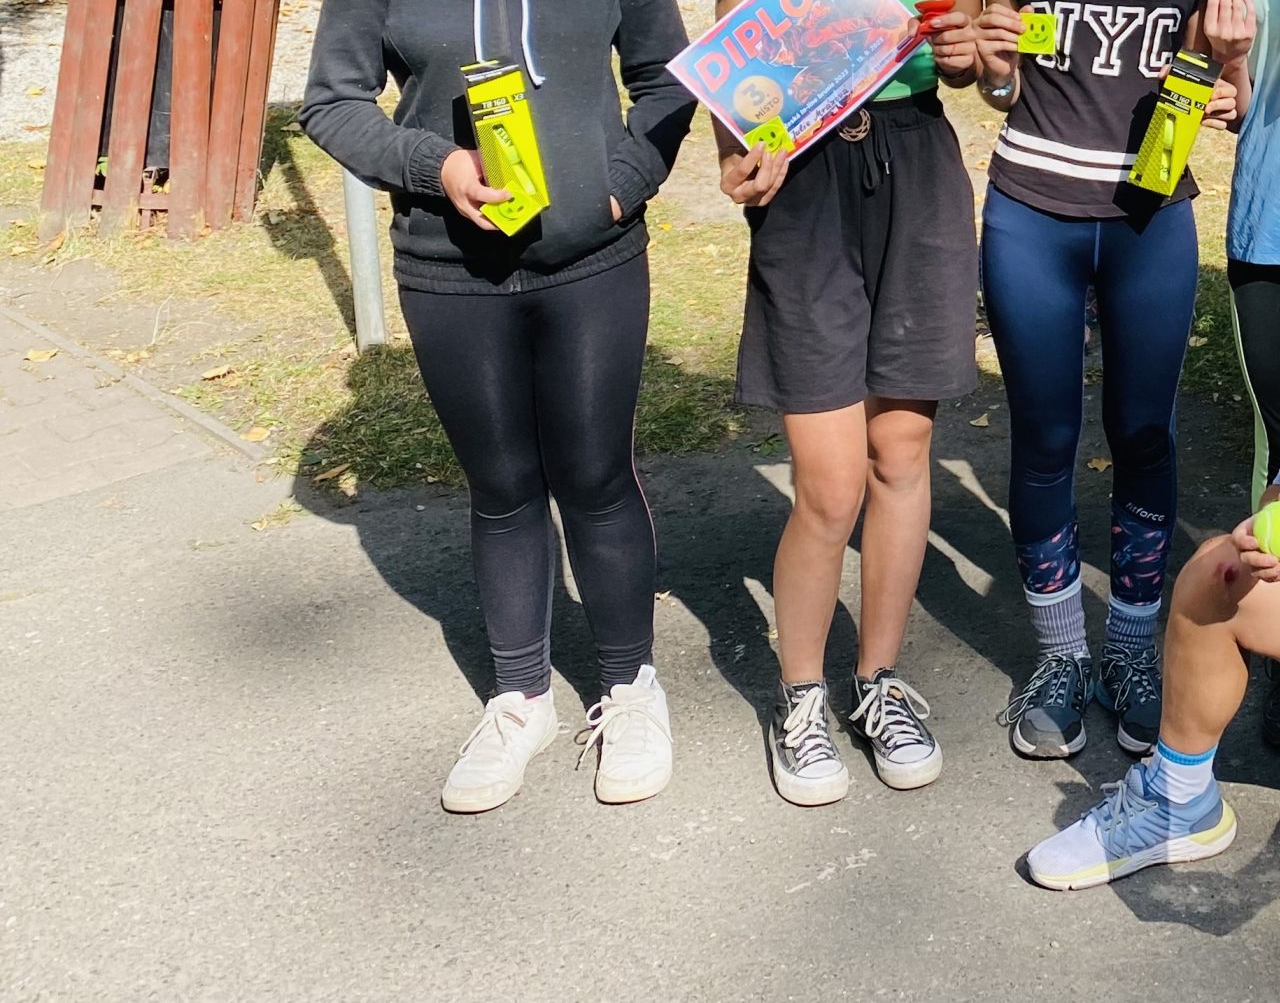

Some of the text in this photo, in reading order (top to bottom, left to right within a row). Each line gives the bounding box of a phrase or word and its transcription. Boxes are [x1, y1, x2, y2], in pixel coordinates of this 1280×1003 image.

[871, 36, 884, 50] 2023
[1030, 2, 1182, 78] NYC
[835, 70, 850, 84] 2023
[494, 98, 506, 107] 160
[741, 82, 770, 106] 3.
[755, 97, 780, 120] MÍSTO
